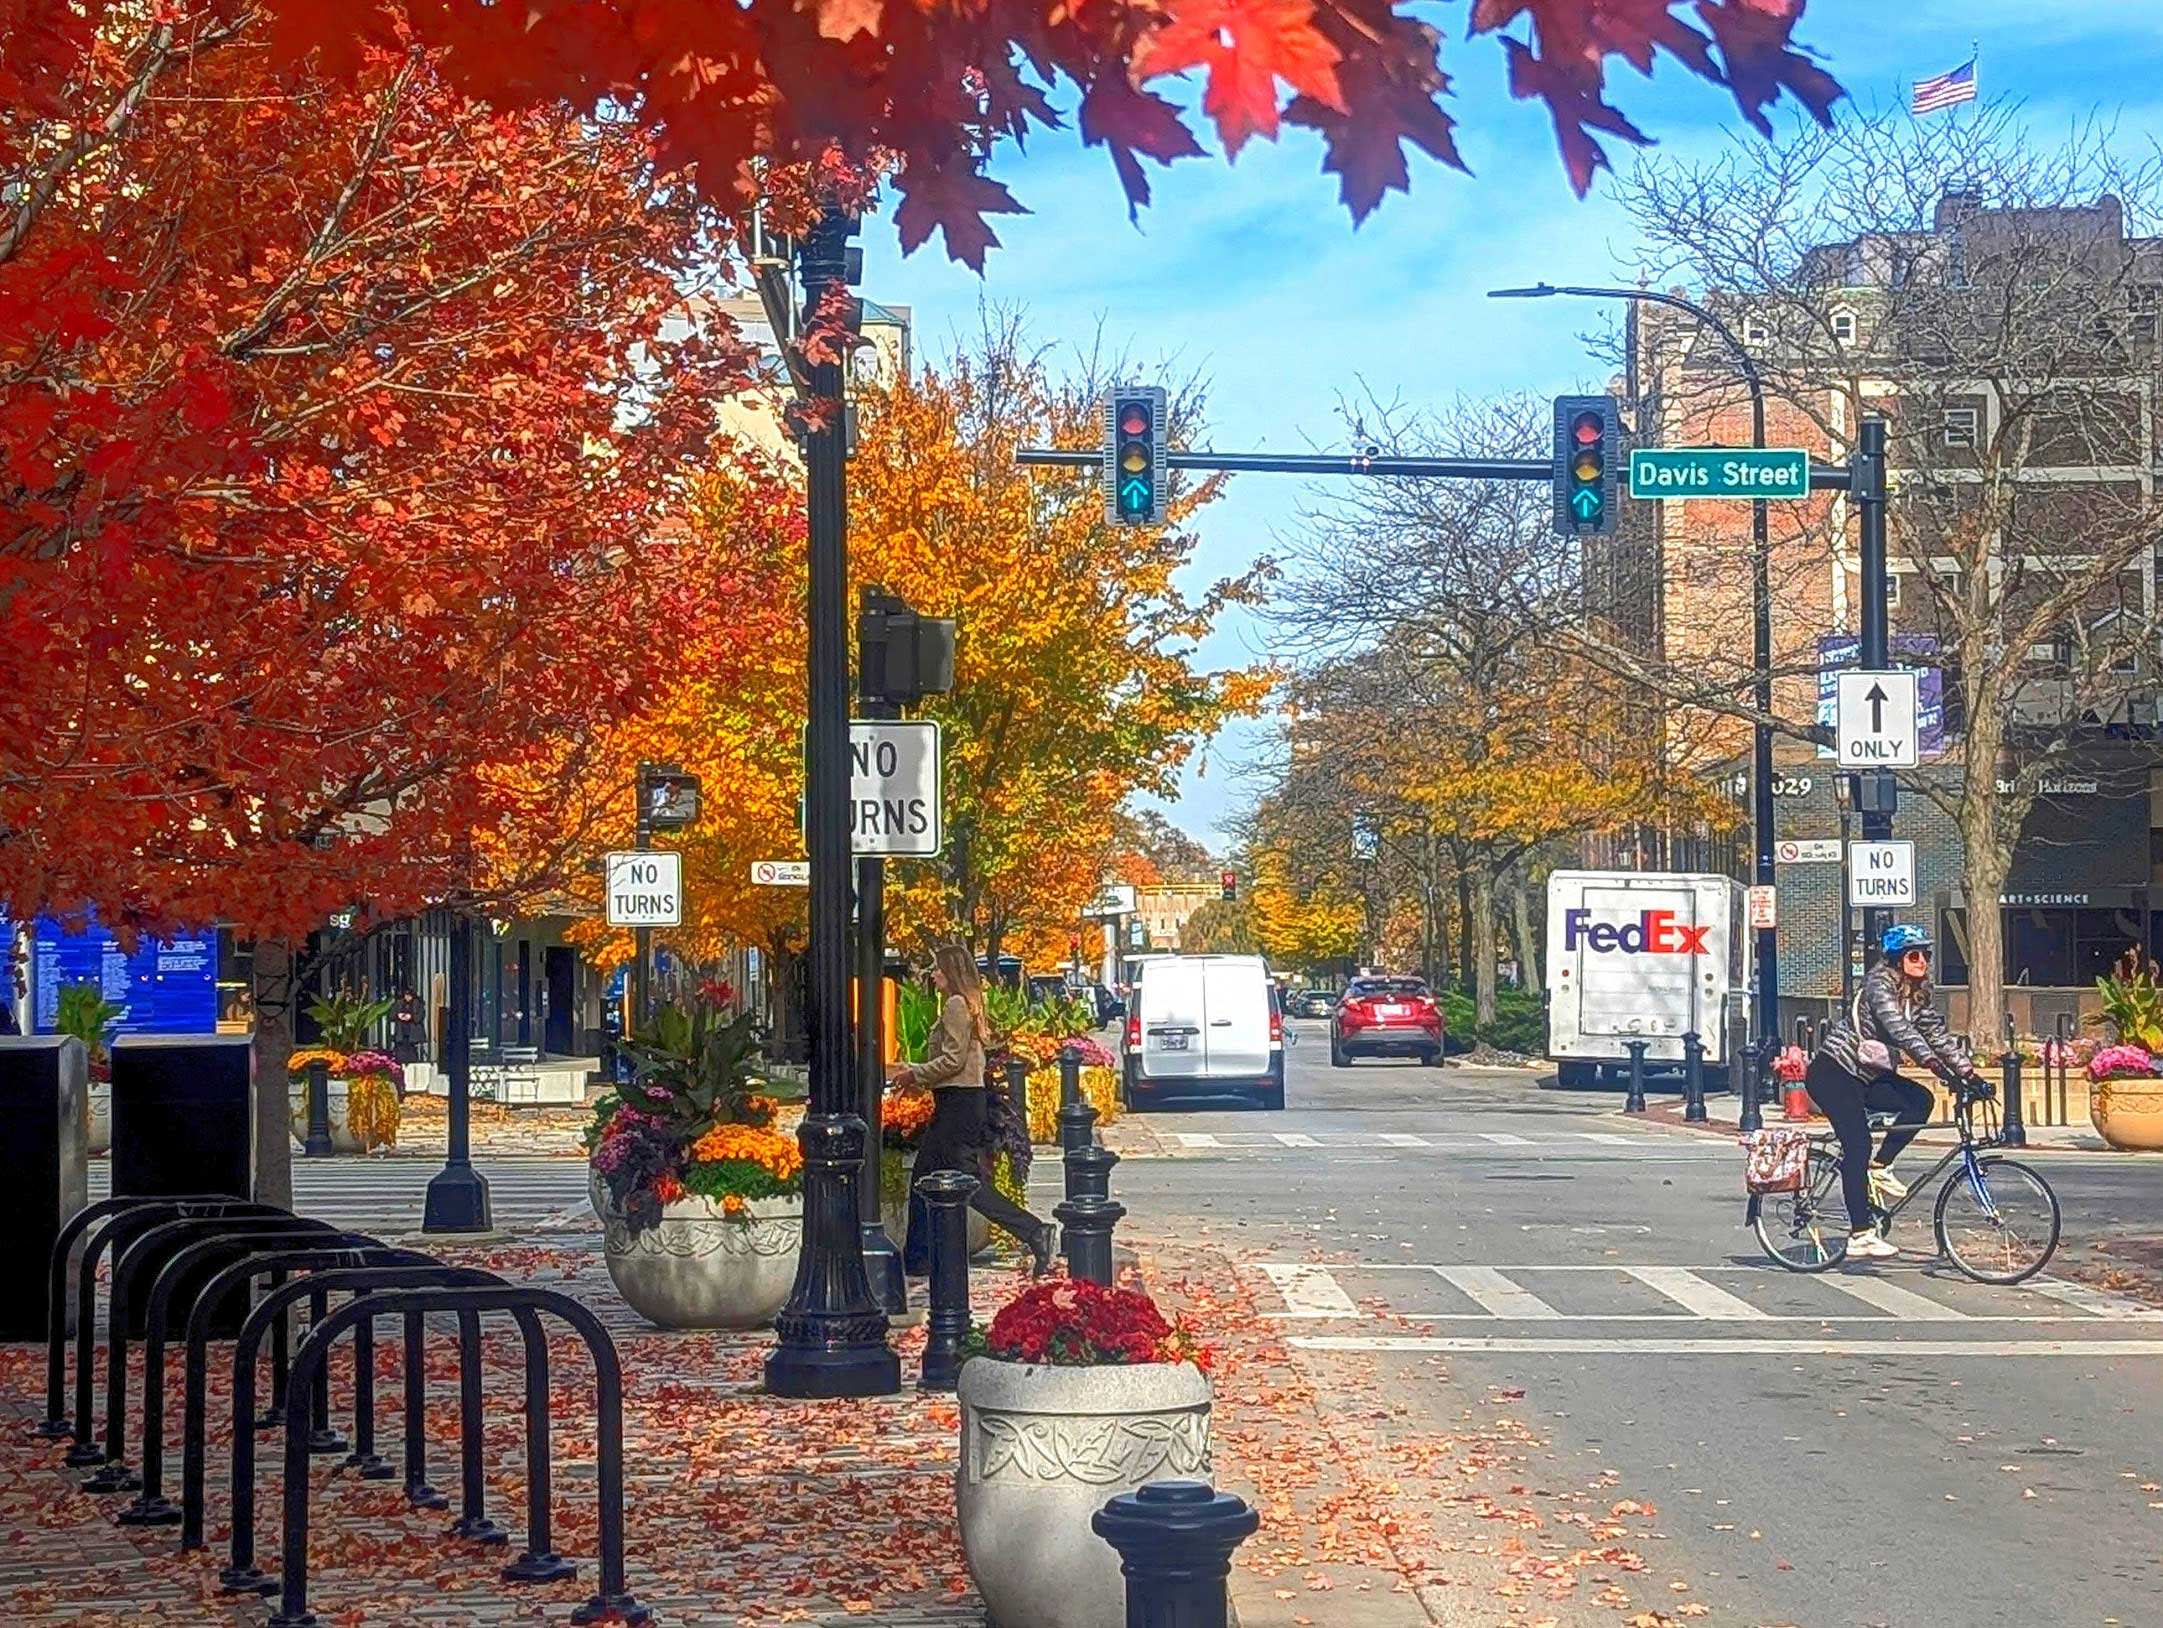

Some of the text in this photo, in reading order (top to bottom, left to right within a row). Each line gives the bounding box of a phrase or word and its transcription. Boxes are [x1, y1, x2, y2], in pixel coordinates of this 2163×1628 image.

[1639, 461, 1799, 487] Davis Street
[850, 741, 897, 777] NO
[1850, 740, 1903, 759] ONLY
[850, 798, 928, 835] RNS
[1870, 851, 1894, 869] NO
[631, 864, 658, 885] NO
[1855, 877, 1910, 897] TURNS
[614, 894, 675, 915] TURNS
[1565, 908, 1712, 954] FedEx
